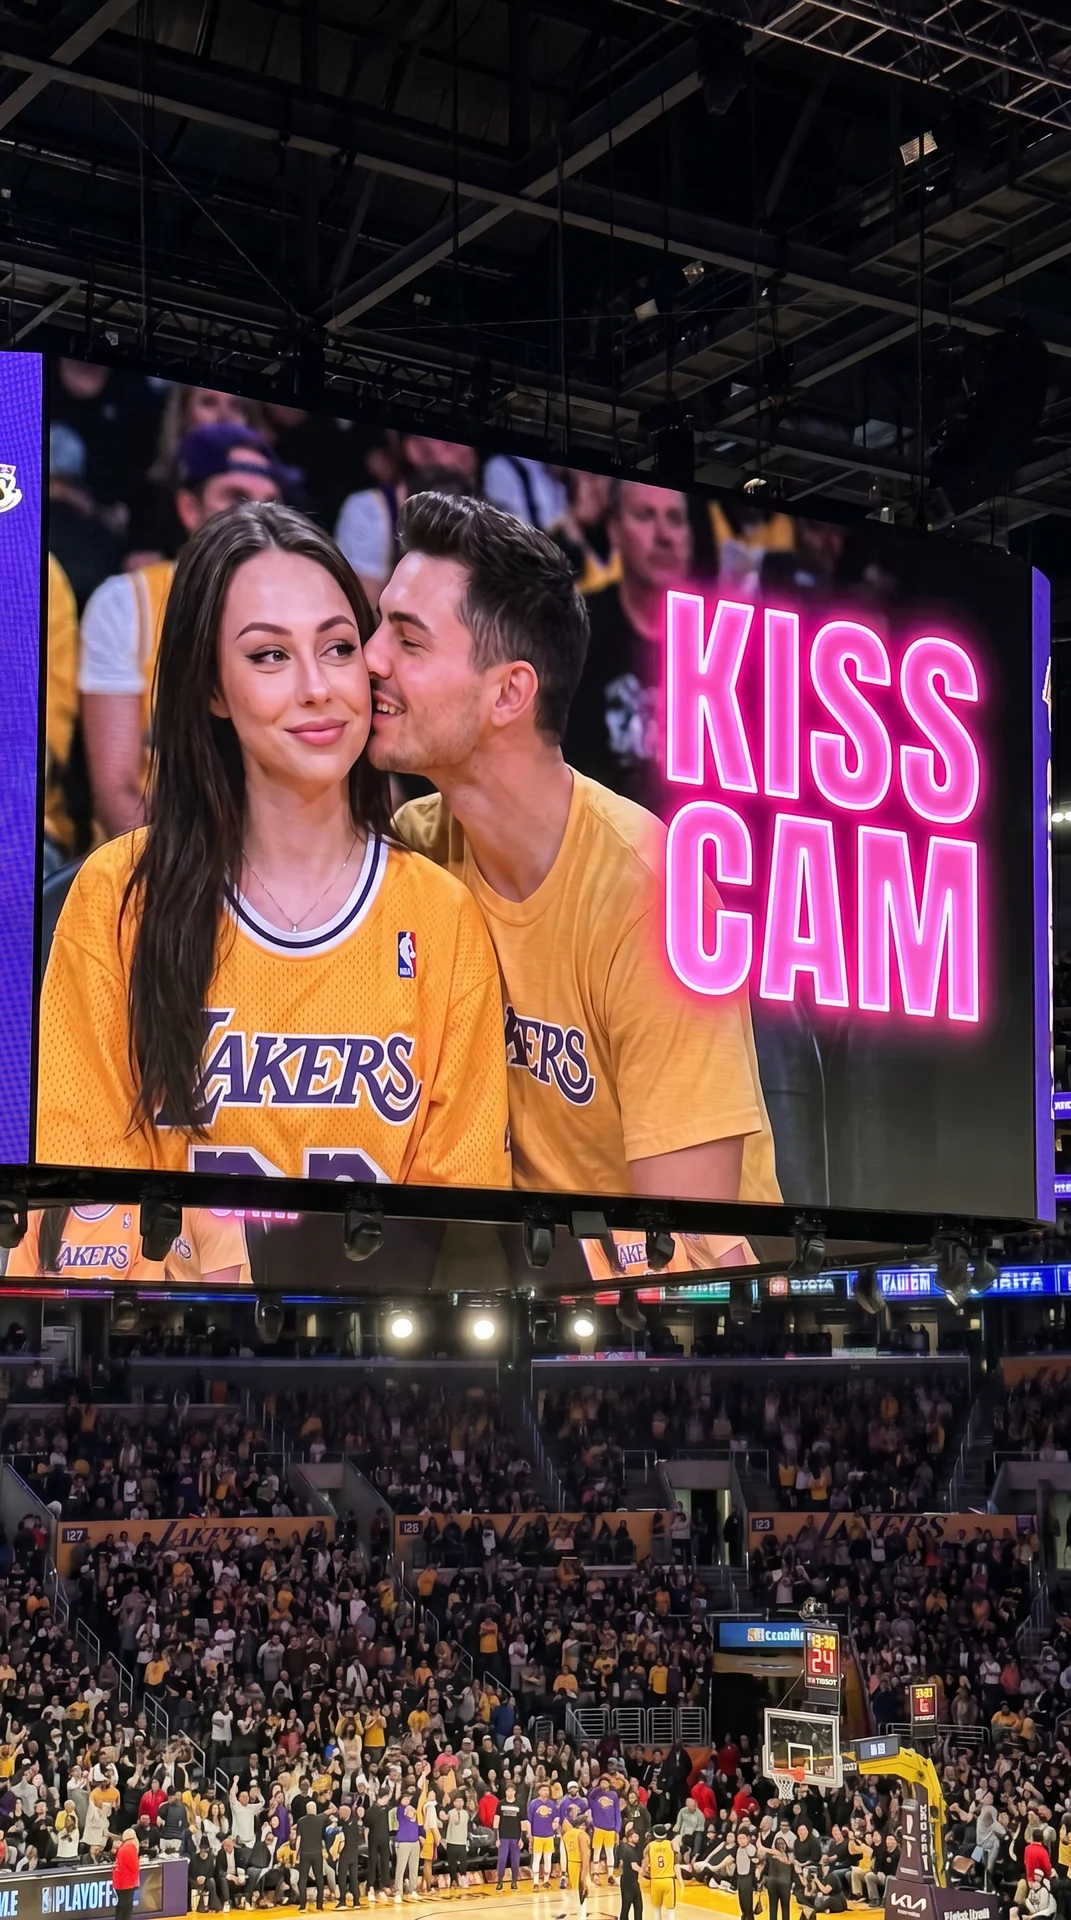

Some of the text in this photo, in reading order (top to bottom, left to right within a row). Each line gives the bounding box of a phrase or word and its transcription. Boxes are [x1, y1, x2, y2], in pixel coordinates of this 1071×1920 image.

[667, 590, 980, 824] KISS
[665, 800, 979, 1022] CAM
[66, 1531, 83, 1541] 127
[755, 1519, 770, 1530] 123
[817, 1511, 948, 1543] LAERS
[812, 1649, 833, 1674] 24
